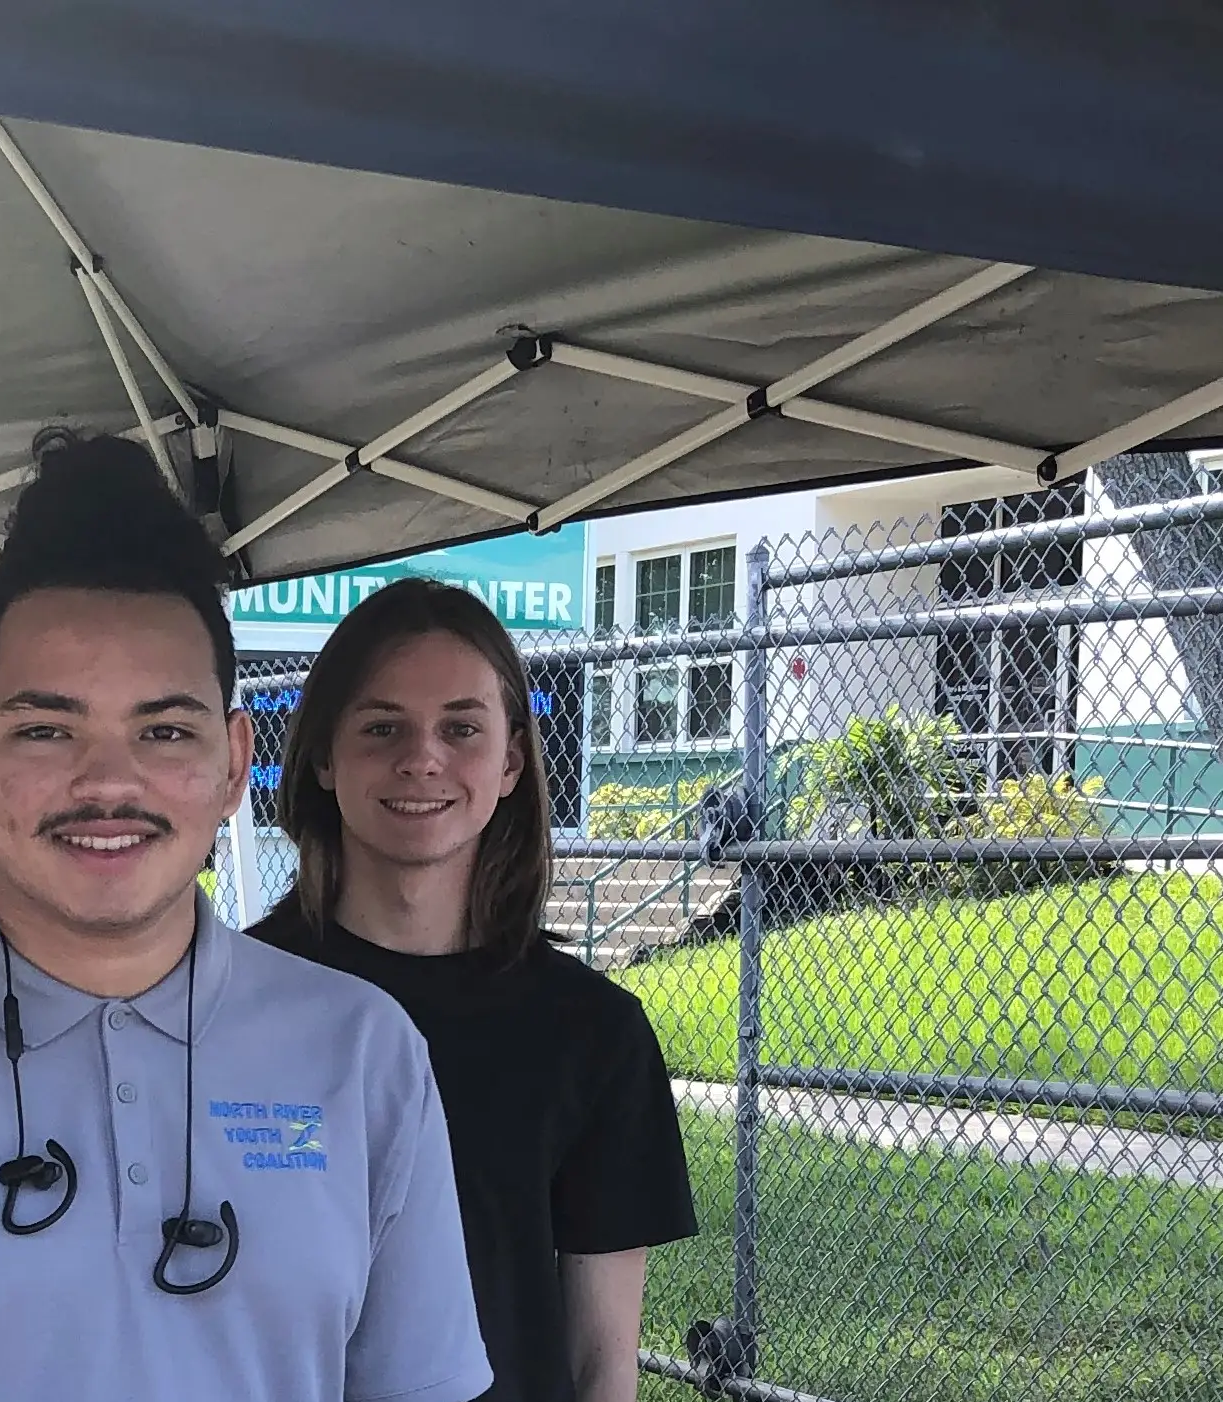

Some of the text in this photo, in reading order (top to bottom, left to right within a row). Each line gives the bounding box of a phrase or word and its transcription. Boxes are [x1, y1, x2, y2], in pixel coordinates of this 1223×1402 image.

[232, 574, 387, 616] MUNIT
[209, 1100, 323, 1121] NORTH RIVER
[224, 1127, 282, 1144] YOUTH
[242, 1152, 327, 1171] COALITION
